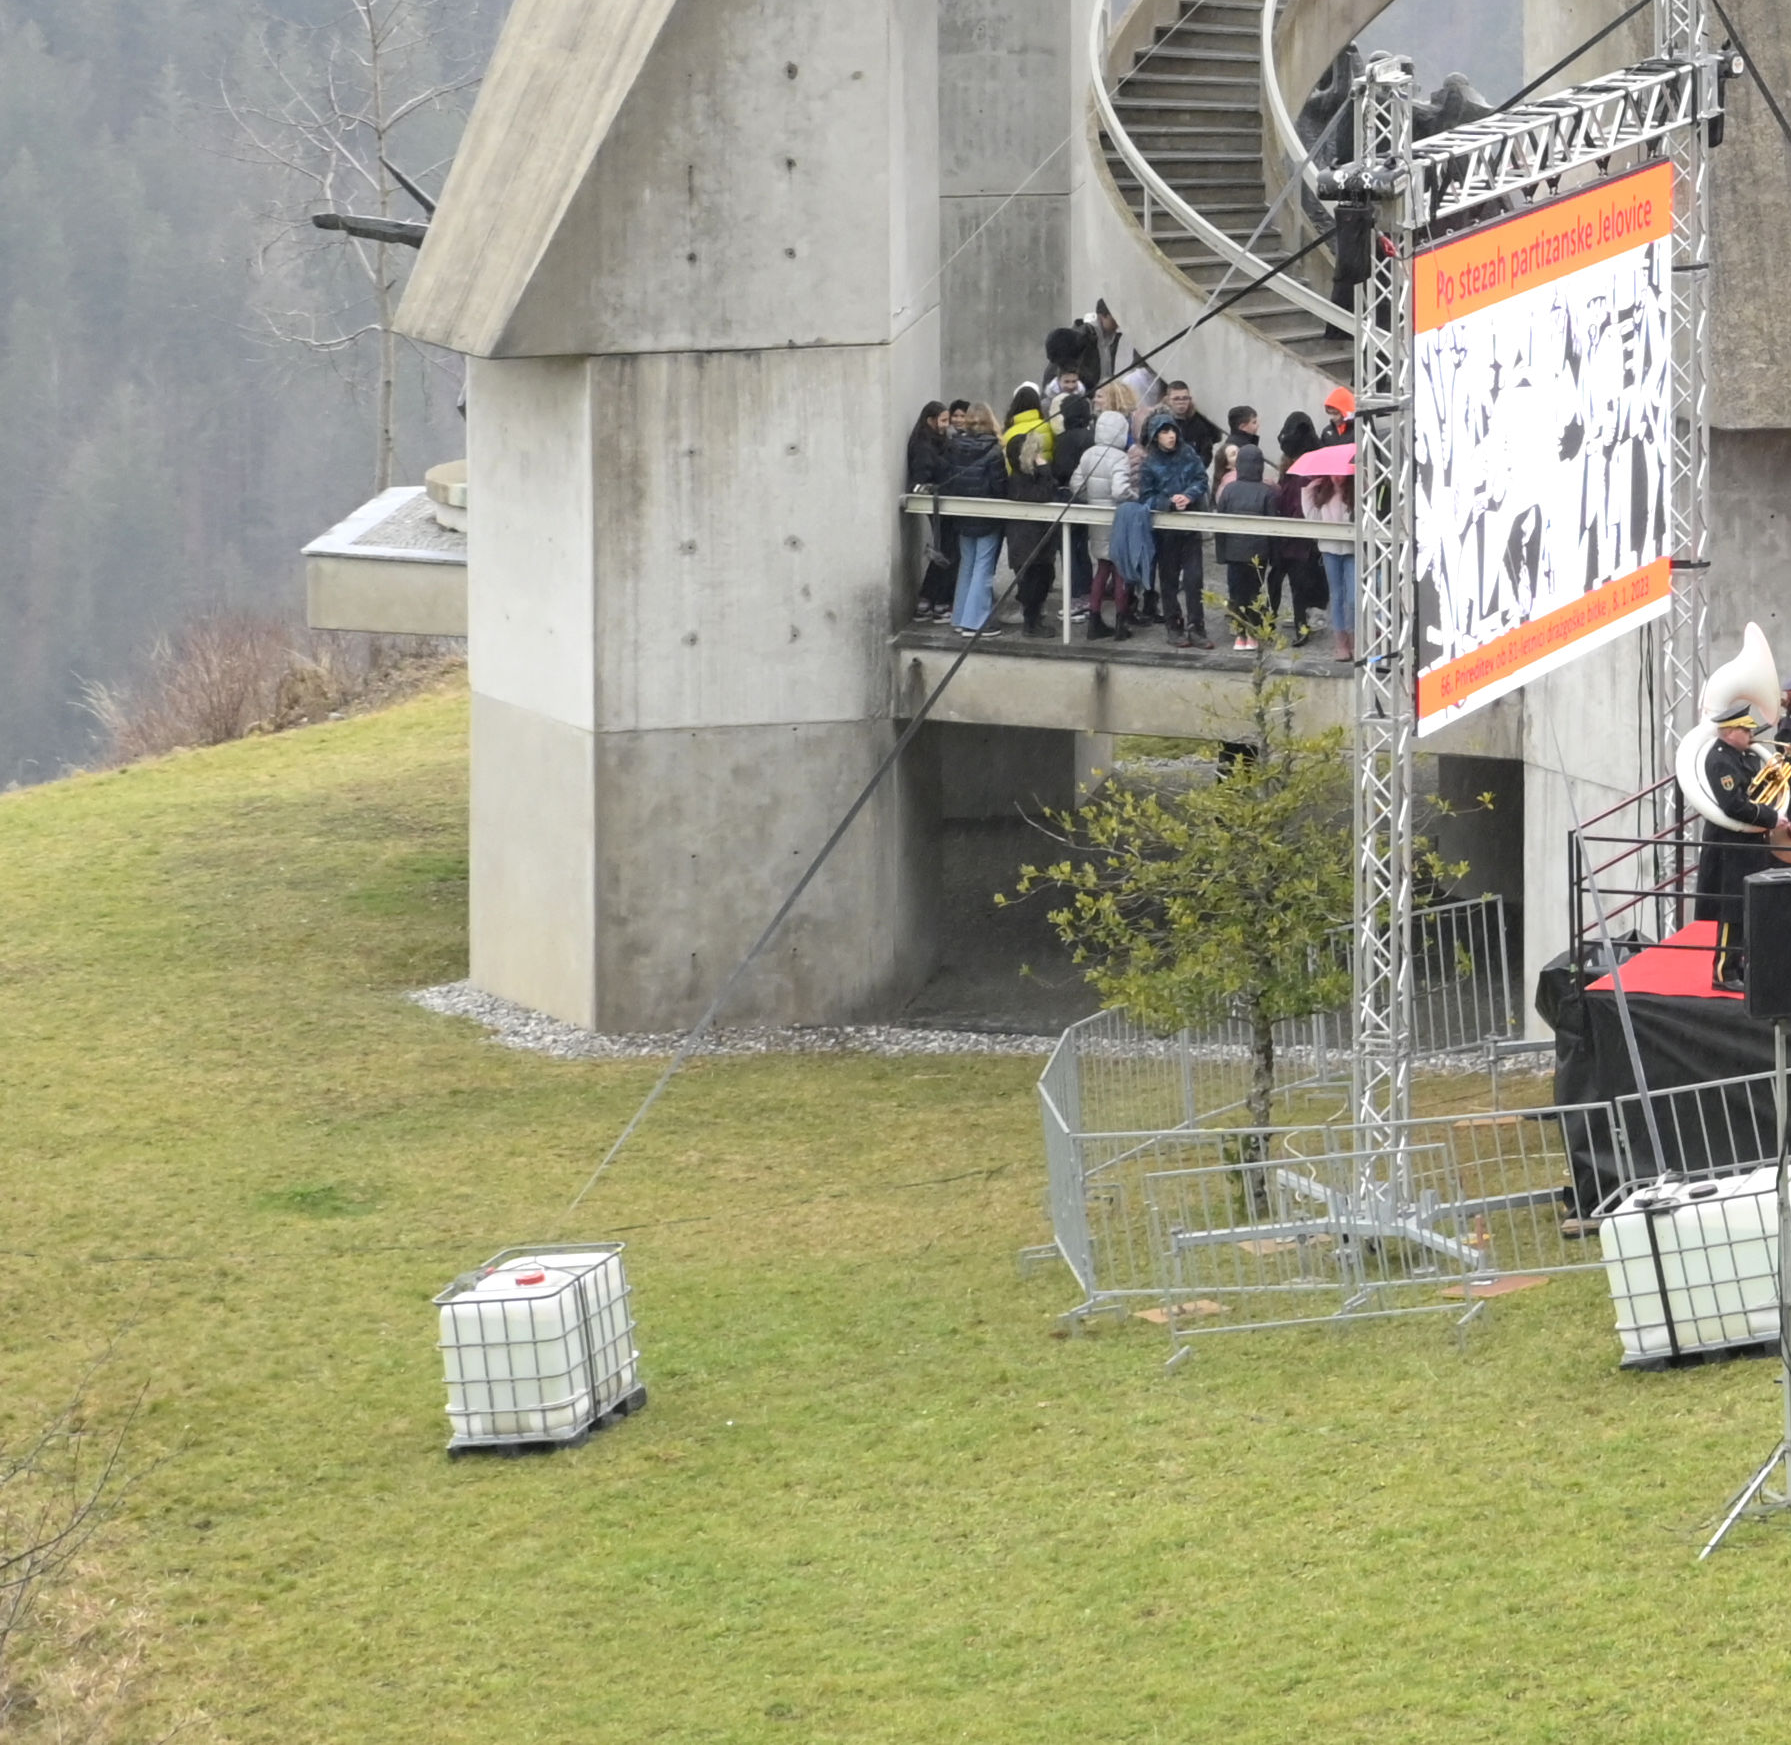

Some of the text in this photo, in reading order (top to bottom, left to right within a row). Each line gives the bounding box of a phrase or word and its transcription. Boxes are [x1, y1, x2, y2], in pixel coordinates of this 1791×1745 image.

[1436, 195, 1652, 309] Po stezah partizanske Jelovice
[1630, 575, 1650, 602] 2023
